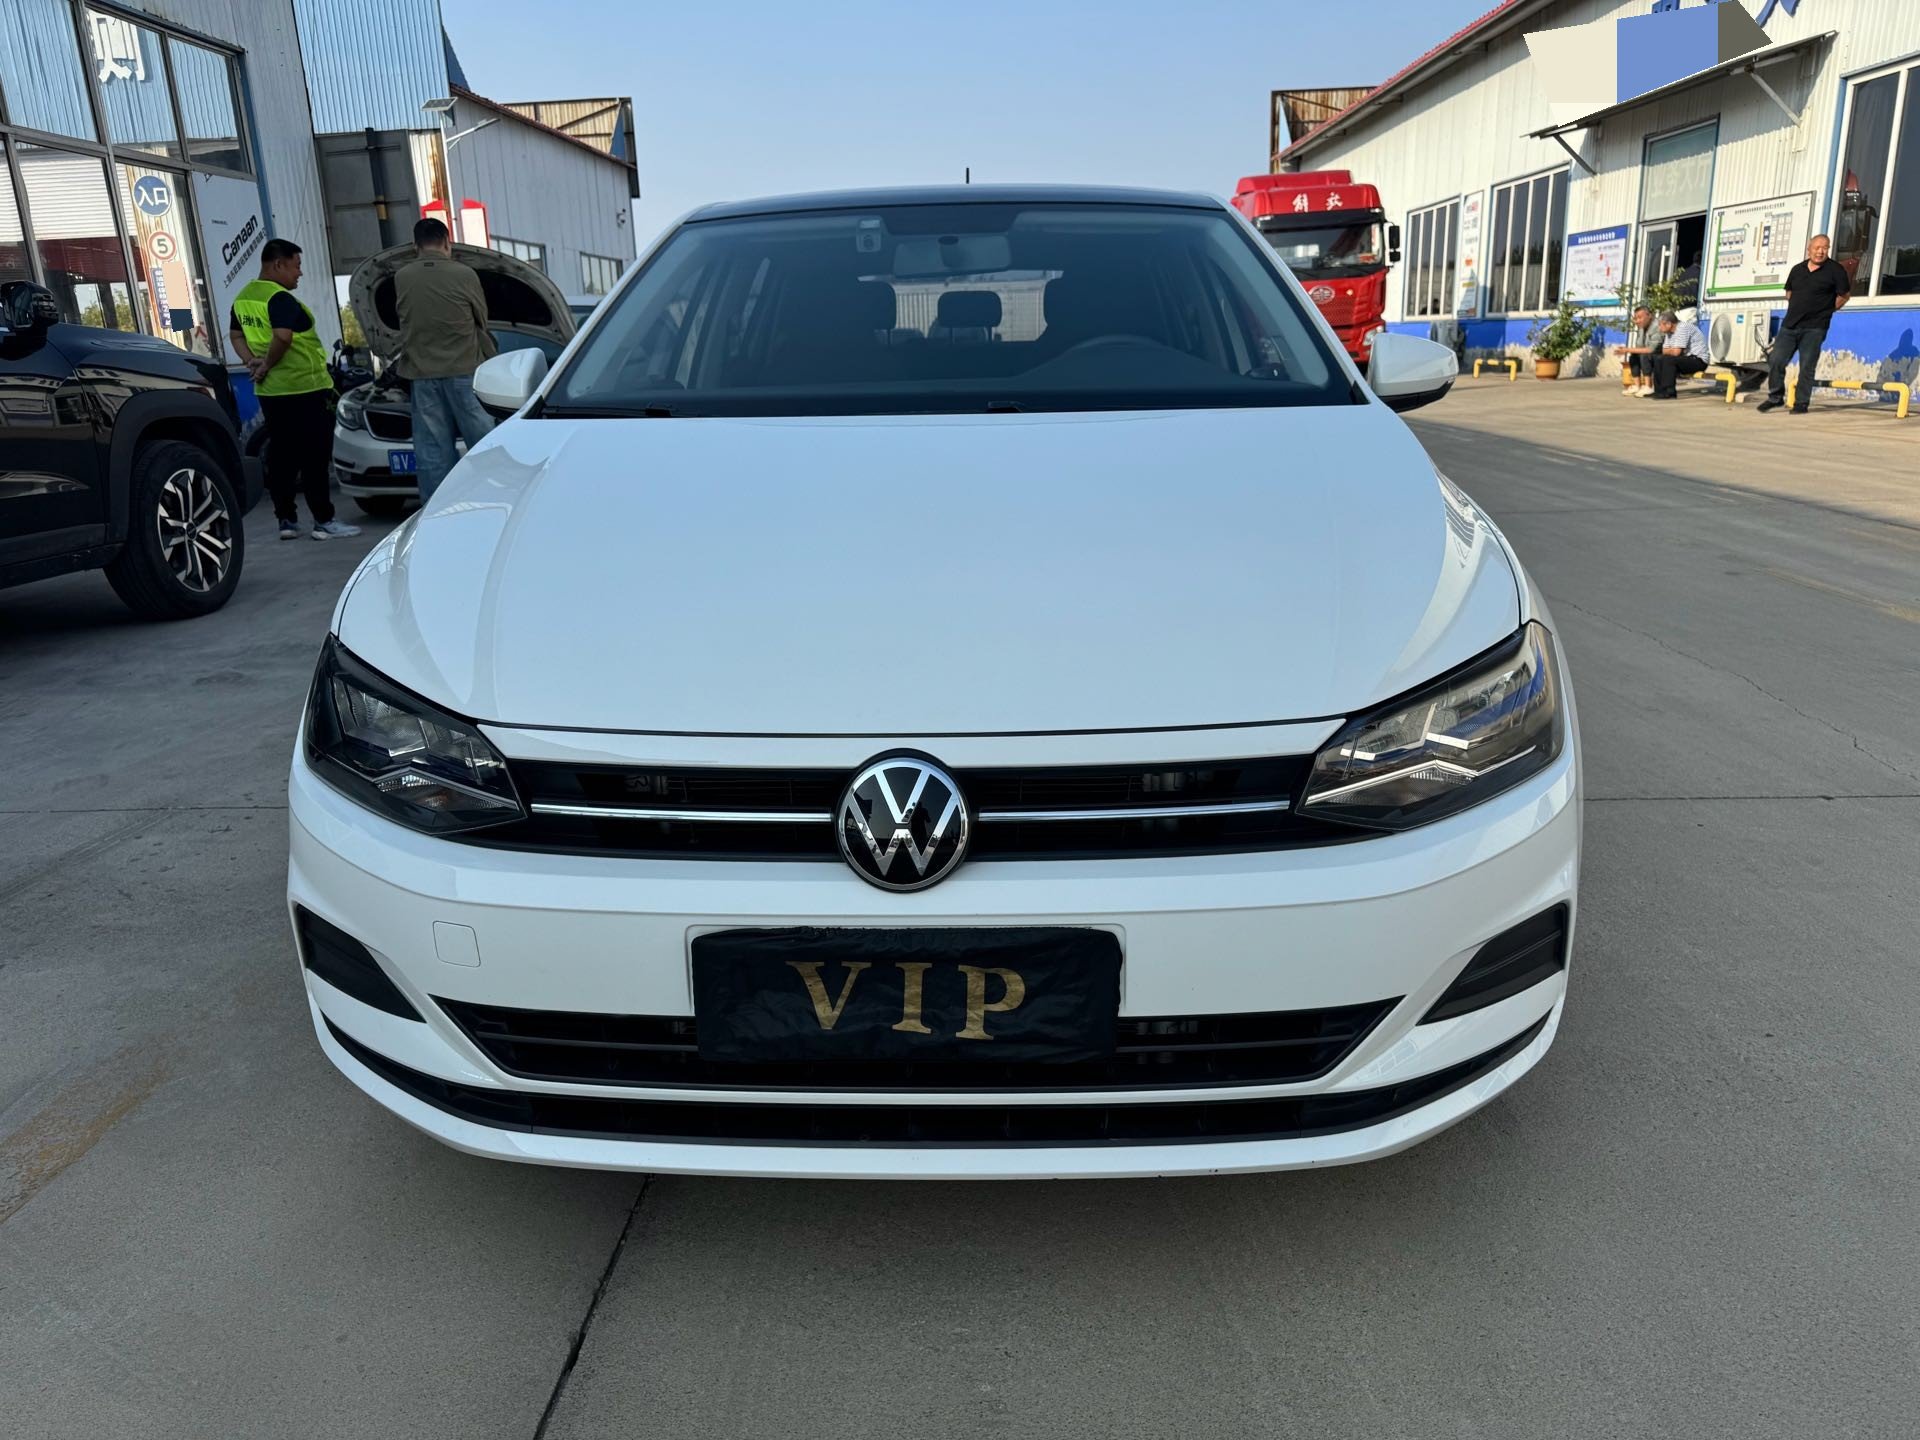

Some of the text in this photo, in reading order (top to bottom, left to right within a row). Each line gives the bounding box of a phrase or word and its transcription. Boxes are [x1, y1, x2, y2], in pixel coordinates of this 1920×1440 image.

[138, 186, 169, 208] 入口
[156, 238, 169, 254] 5
[221, 214, 259, 266] Canaan
[785, 960, 1027, 1041] VIP
